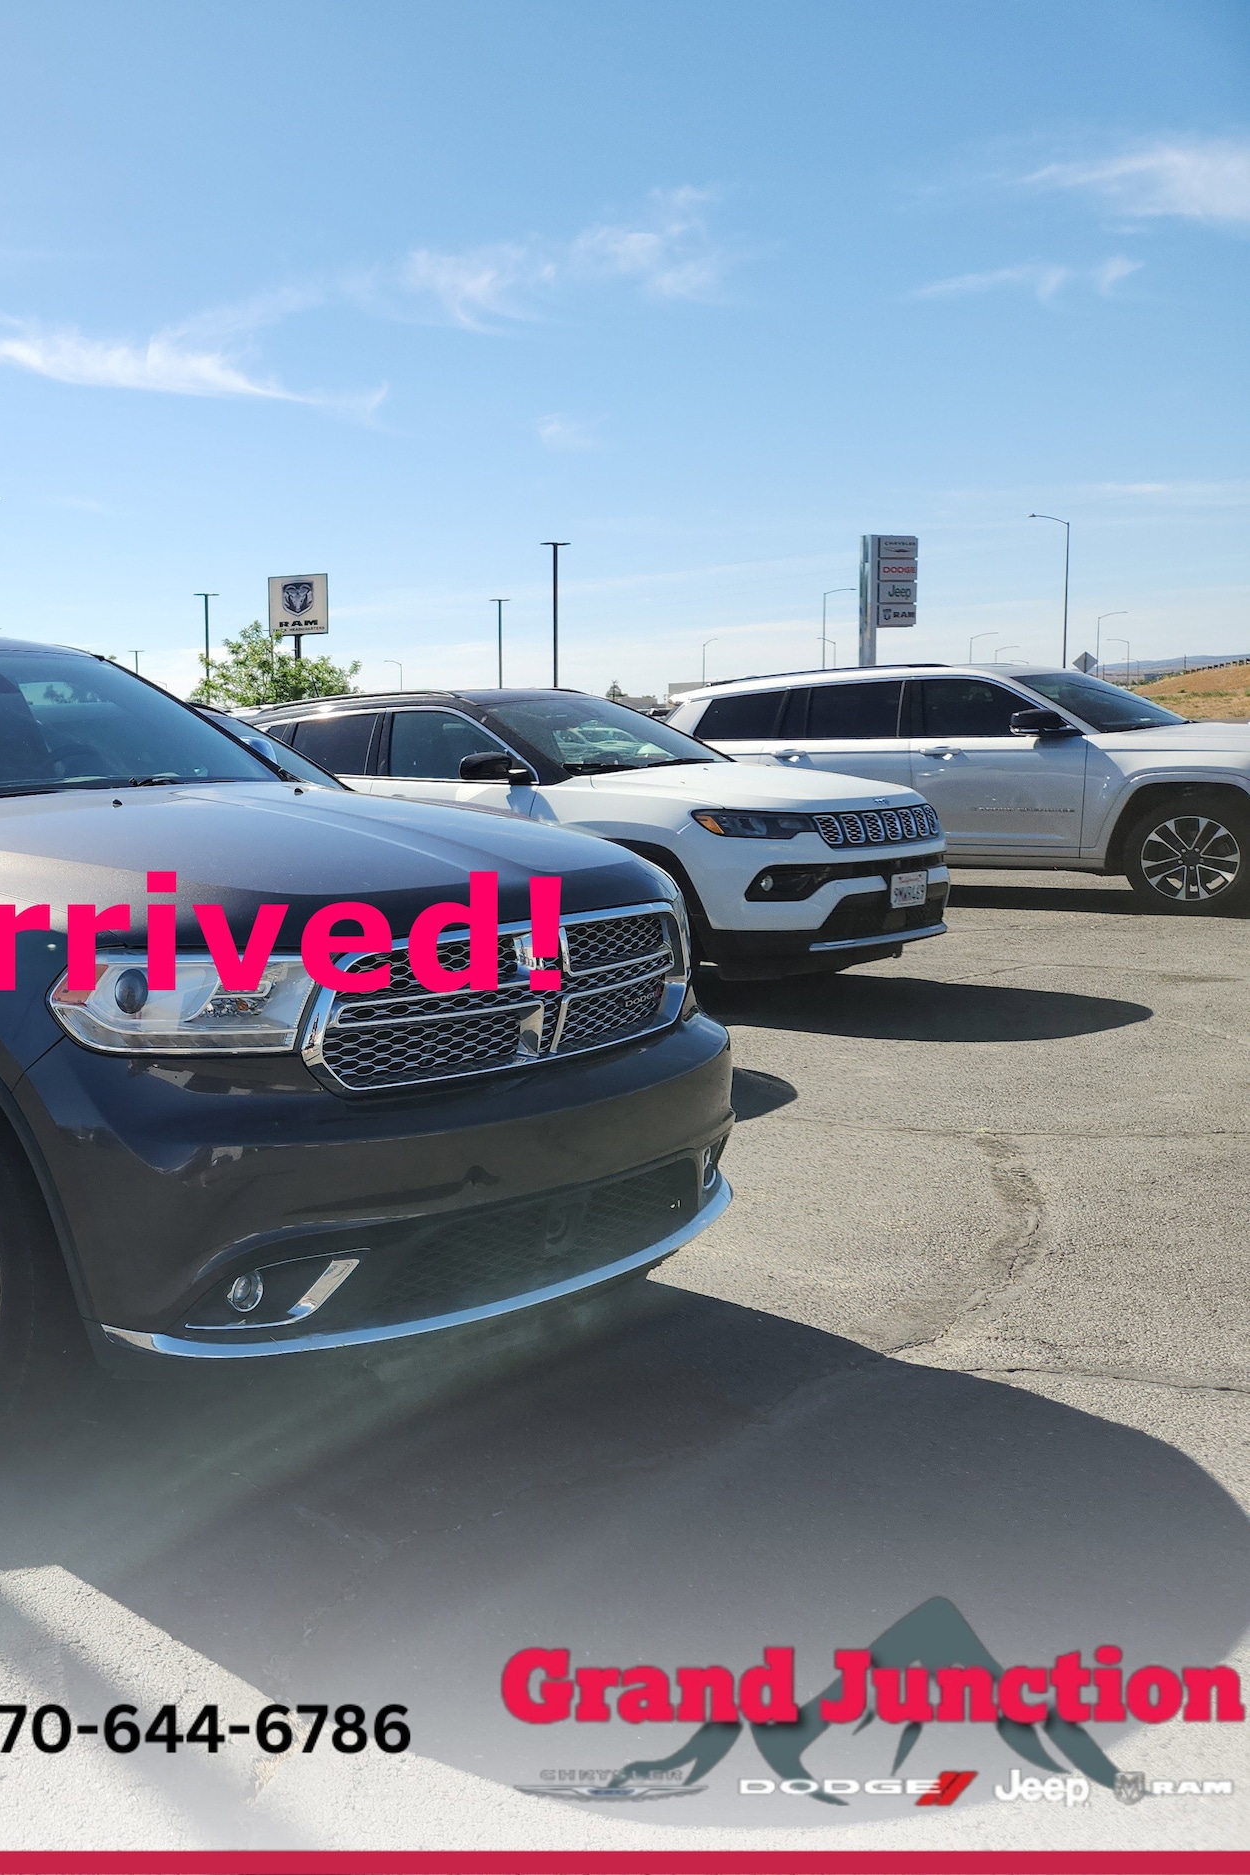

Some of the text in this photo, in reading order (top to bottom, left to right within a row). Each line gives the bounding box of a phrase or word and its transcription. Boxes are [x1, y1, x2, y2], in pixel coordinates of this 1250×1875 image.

[882, 566, 916, 574] DODGE
[888, 584, 912, 599] Jeep
[279, 619, 319, 628] RAM
